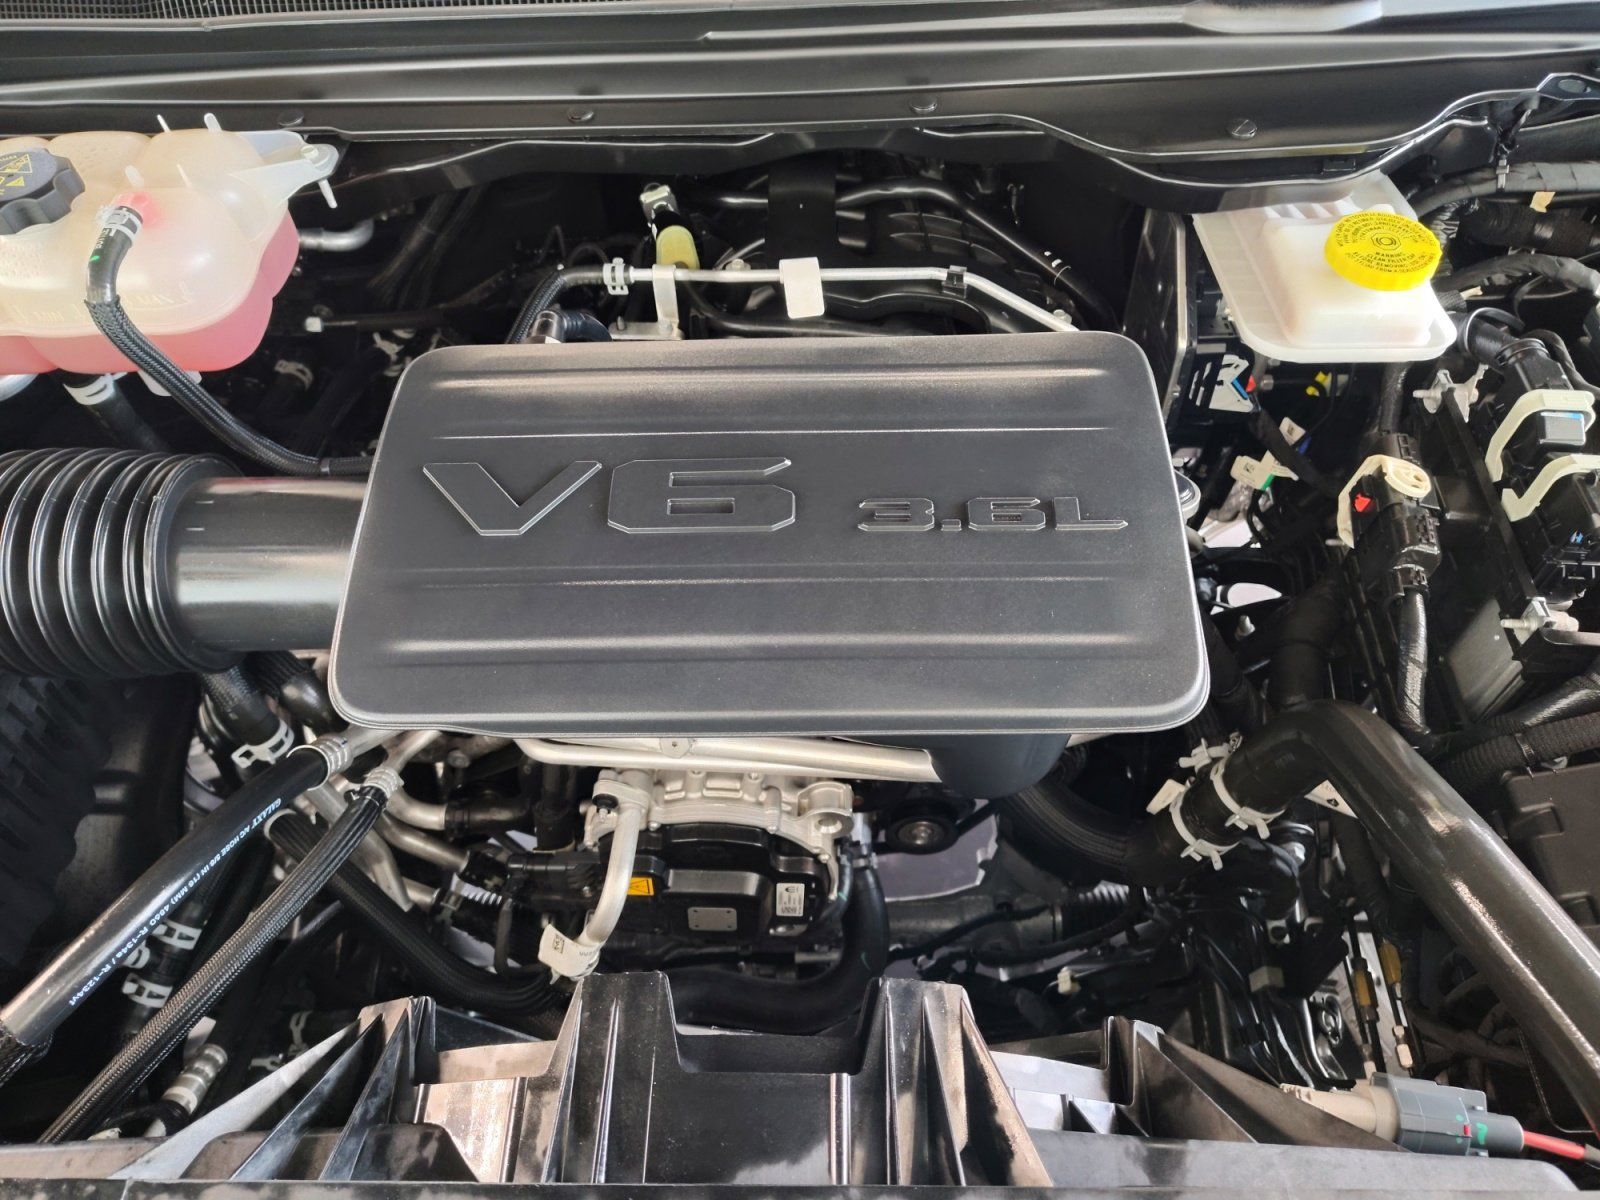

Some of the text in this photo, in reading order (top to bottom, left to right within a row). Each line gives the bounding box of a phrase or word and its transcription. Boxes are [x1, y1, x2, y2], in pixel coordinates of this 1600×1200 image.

[423, 456, 1129, 536] V6 3.6L
[251, 797, 282, 829] GALAXY
[239, 824, 251, 839] A/C
[220, 835, 240, 857] HOSE
[200, 864, 210, 876] IN
[170, 886, 189, 905] MM)
[115, 926, 149, 958] R-134a
[69, 963, 112, 1007] R-1234yf
